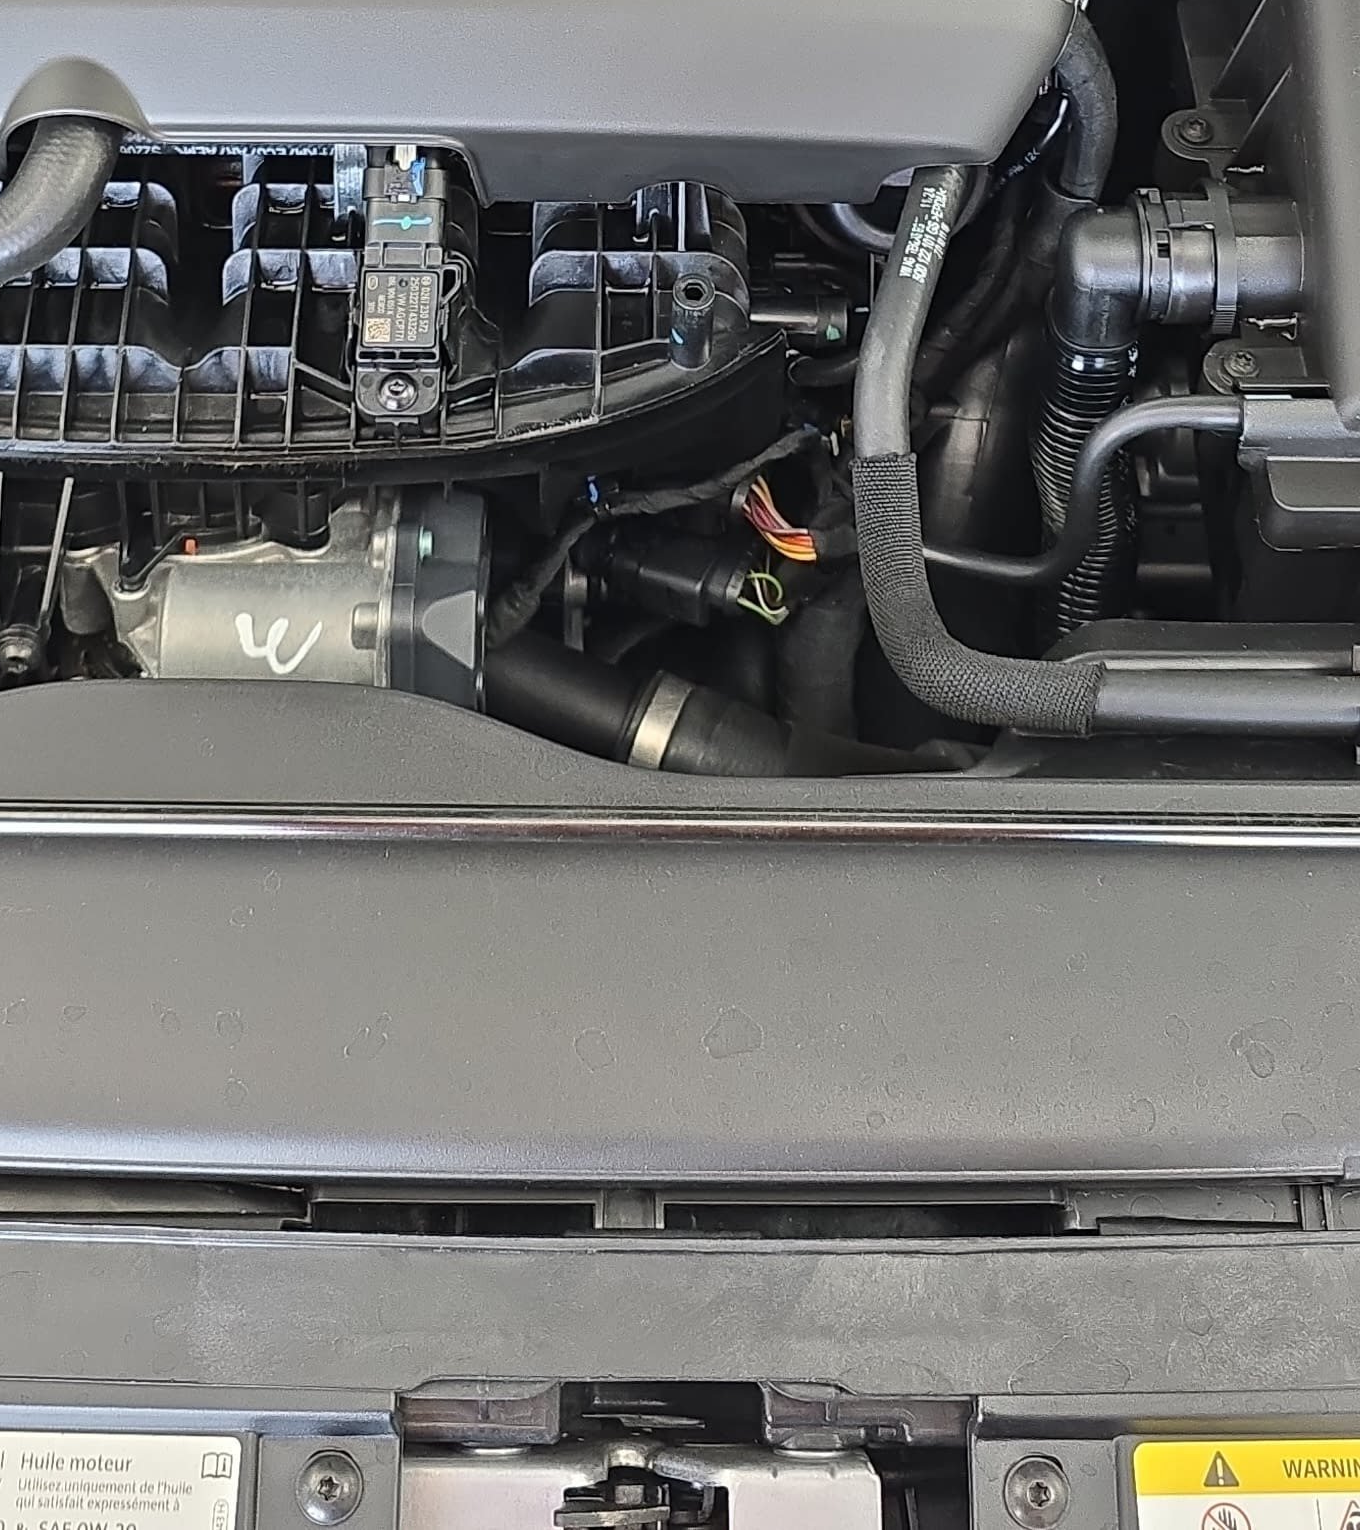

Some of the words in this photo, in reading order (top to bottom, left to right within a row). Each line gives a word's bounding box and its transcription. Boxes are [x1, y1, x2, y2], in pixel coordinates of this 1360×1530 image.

[20, 1451, 65, 1471] Huile
[69, 1453, 133, 1472] moteur
[64, 1479, 136, 1496] uniquement
[139, 1480, 155, 1495] de
[157, 1480, 193, 1496] l'huile
[16, 1495, 36, 1511] qui
[38, 1494, 84, 1509] satisfait
[87, 1496, 170, 1514] expressément
[172, 1498, 180, 1512] à
